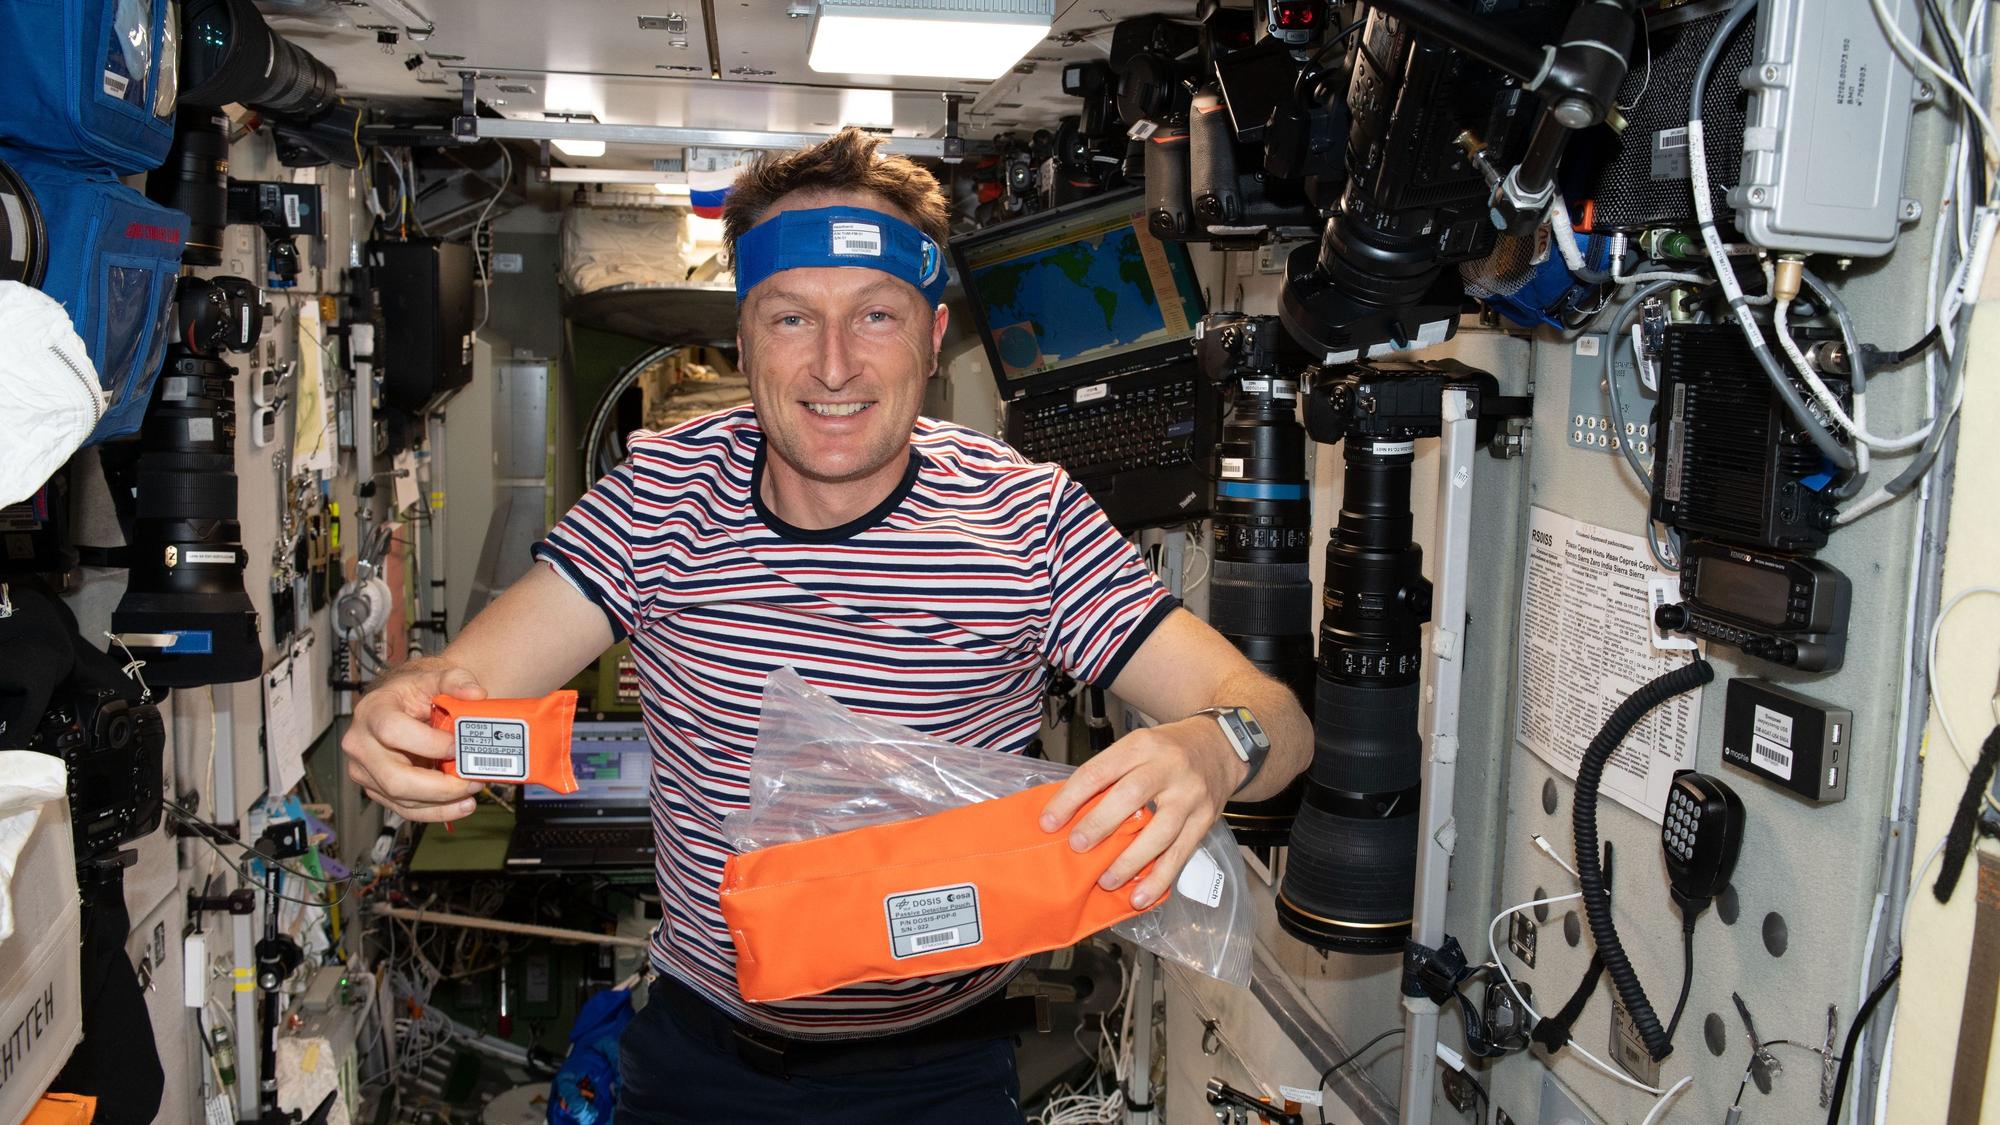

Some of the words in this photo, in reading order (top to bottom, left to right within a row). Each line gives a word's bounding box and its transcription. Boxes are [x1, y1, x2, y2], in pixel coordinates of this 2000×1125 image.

[1592, 548, 1605, 558] Ноль
[1605, 552, 1618, 562] Иван
[1619, 556, 1638, 568] Сергей
[1590, 557, 1601, 568] Zero
[1601, 560, 1612, 571] India
[1613, 564, 1628, 576] Sierra
[1629, 568, 1645, 580] Sierra
[504, 732, 521, 740] esa
[1730, 749, 1750, 763] mophie
[1212, 872, 1223, 900] Pouch
[913, 897, 942, 908] DOSIS
[922, 906, 949, 915] Detector
[0, 982, 54, 1091] НТГЕН
